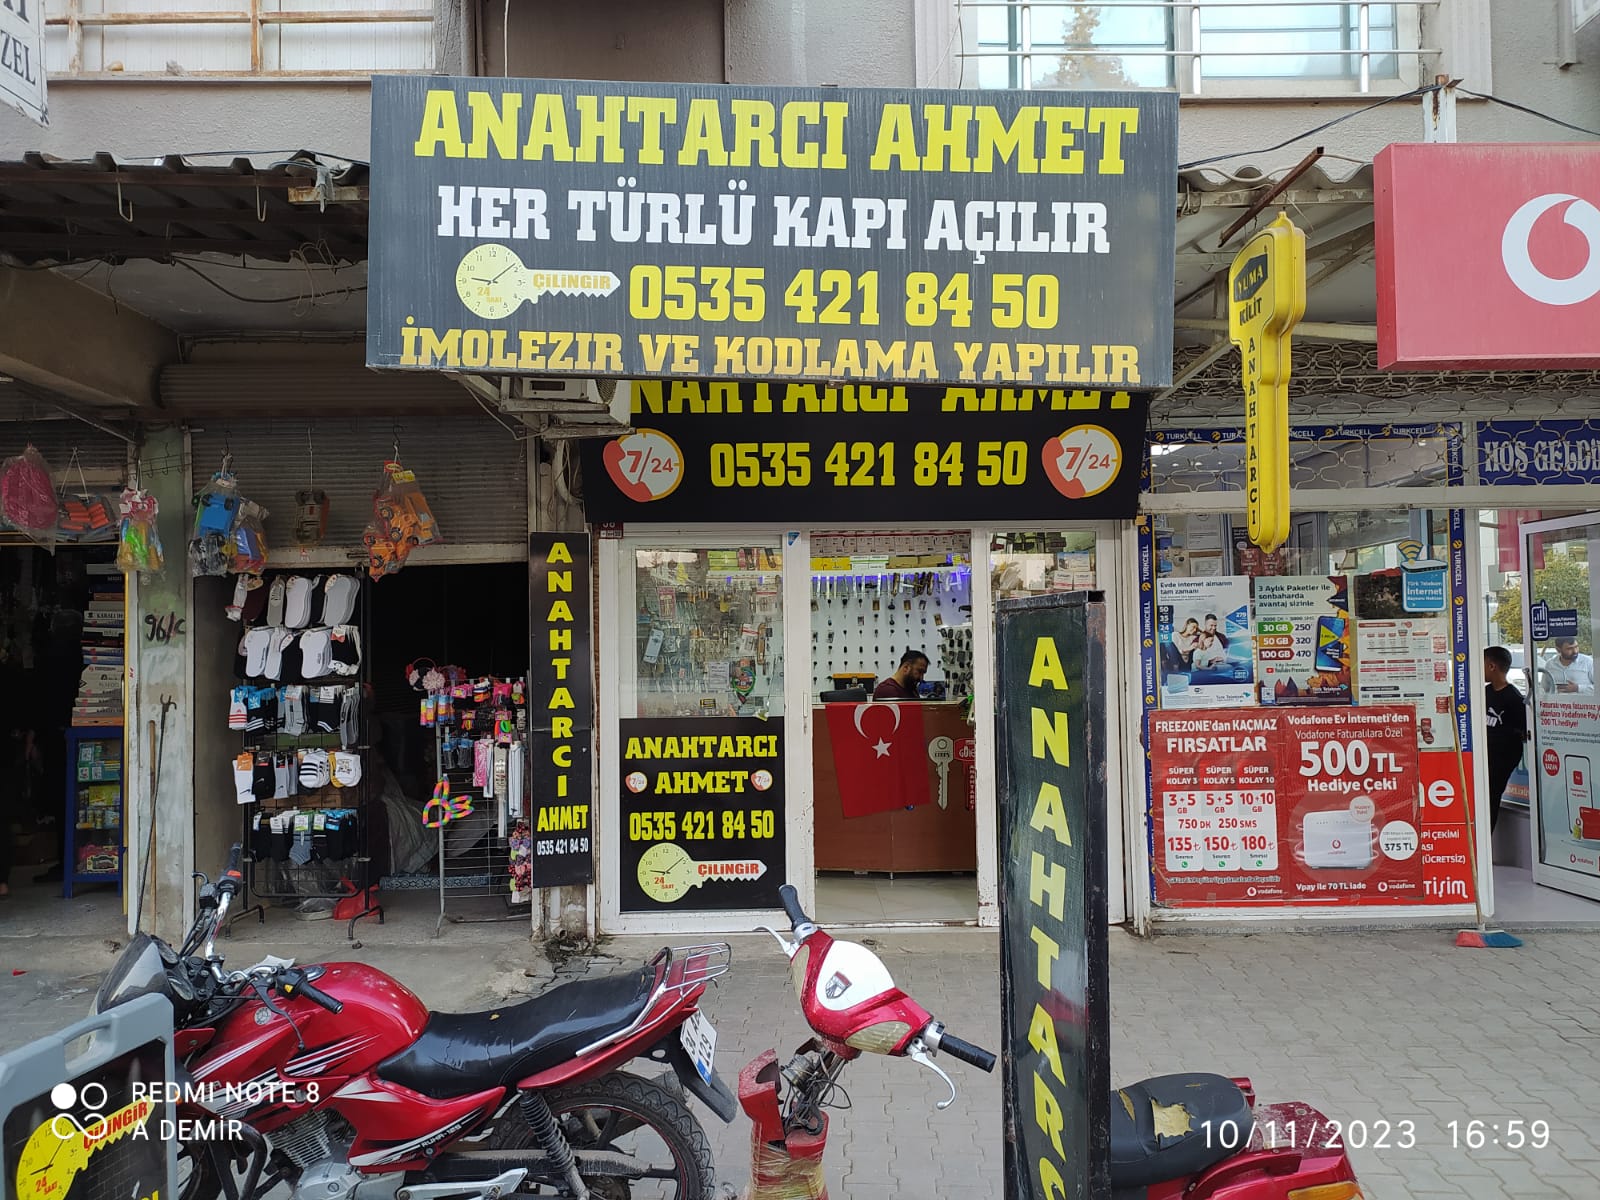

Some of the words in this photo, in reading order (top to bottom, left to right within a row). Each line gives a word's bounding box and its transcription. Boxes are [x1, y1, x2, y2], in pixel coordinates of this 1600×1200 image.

[414, 90, 848, 168] ANAHTARCI
[870, 103, 1139, 175] AHMET
[437, 185, 550, 240] HER
[567, 176, 756, 245] TÜRLÜ
[773, 195, 907, 250] KAPI
[923, 200, 1110, 265] AÇILIR
[477, 286, 491, 296] 24
[629, 265, 766, 322] 0535
[785, 269, 879, 325] 421
[905, 272, 973, 328] 84
[991, 274, 1059, 329] 50
[400, 316, 624, 371] İMOLEZIR
[639, 334, 699, 373] VE
[714, 336, 939, 379] KODLAMA
[954, 342, 1141, 384] YAPILIR
[1247, 336, 1258, 525] ANAHTARCI
[626, 447, 674, 481] 7/24
[710, 442, 812, 487] 0535
[825, 441, 896, 487] 421
[913, 441, 964, 487] 84
[977, 441, 1028, 486] 50
[1065, 443, 1111, 478] 7/24
[1484, 441, 1529, 477] HOŞ
[1534, 438, 1600, 472] GELDİ
[1455, 549, 1463, 587] TURKCELL
[1456, 606, 1465, 644] TURKCELL
[546, 542, 575, 797] ANAHTARCI
[1458, 662, 1468, 700] TURKCELL
[1156, 720, 1230, 732] FREEZONE'dan
[1232, 719, 1278, 734] KAÇMAZ
[1287, 714, 1333, 725] Vodafone
[1335, 714, 1346, 724] Ev
[1167, 736, 1267, 753] FIRSATLAR
[1295, 730, 1334, 740] Vodafone
[1384, 726, 1404, 738] Özel
[1460, 714, 1469, 751] TURKCELL
[625, 736, 778, 760] ANAHTARCI
[1299, 740, 1370, 776] 500
[1372, 752, 1404, 772] TL
[1168, 766, 1194, 774] SÜPER
[1206, 766, 1232, 774] SÜPER
[1244, 765, 1269, 774] SÜPER
[654, 771, 748, 794] AHMET
[1308, 778, 1360, 794] Hediye
[1364, 778, 1398, 794] Çeki
[537, 805, 588, 832] AHMET
[629, 812, 676, 840] 0535
[682, 811, 715, 840] 421
[722, 810, 746, 840] 84
[750, 810, 774, 839] 50
[1178, 819, 1198, 829] 750
[1200, 820, 1211, 828] DK
[1218, 818, 1238, 828] 250
[1240, 820, 1258, 828] SMS
[537, 840, 554, 855] 0535
[555, 839, 567, 854] 421
[570, 838, 578, 853] 84
[580, 837, 588, 852] 50
[1384, 842, 1402, 850] 375
[1403, 842, 1414, 850] TL
[1432, 830, 1460, 840] ÇEKİMİ
[1422, 854, 1466, 864] (ÜCRETSİZ)
[654, 876, 665, 884] 24
